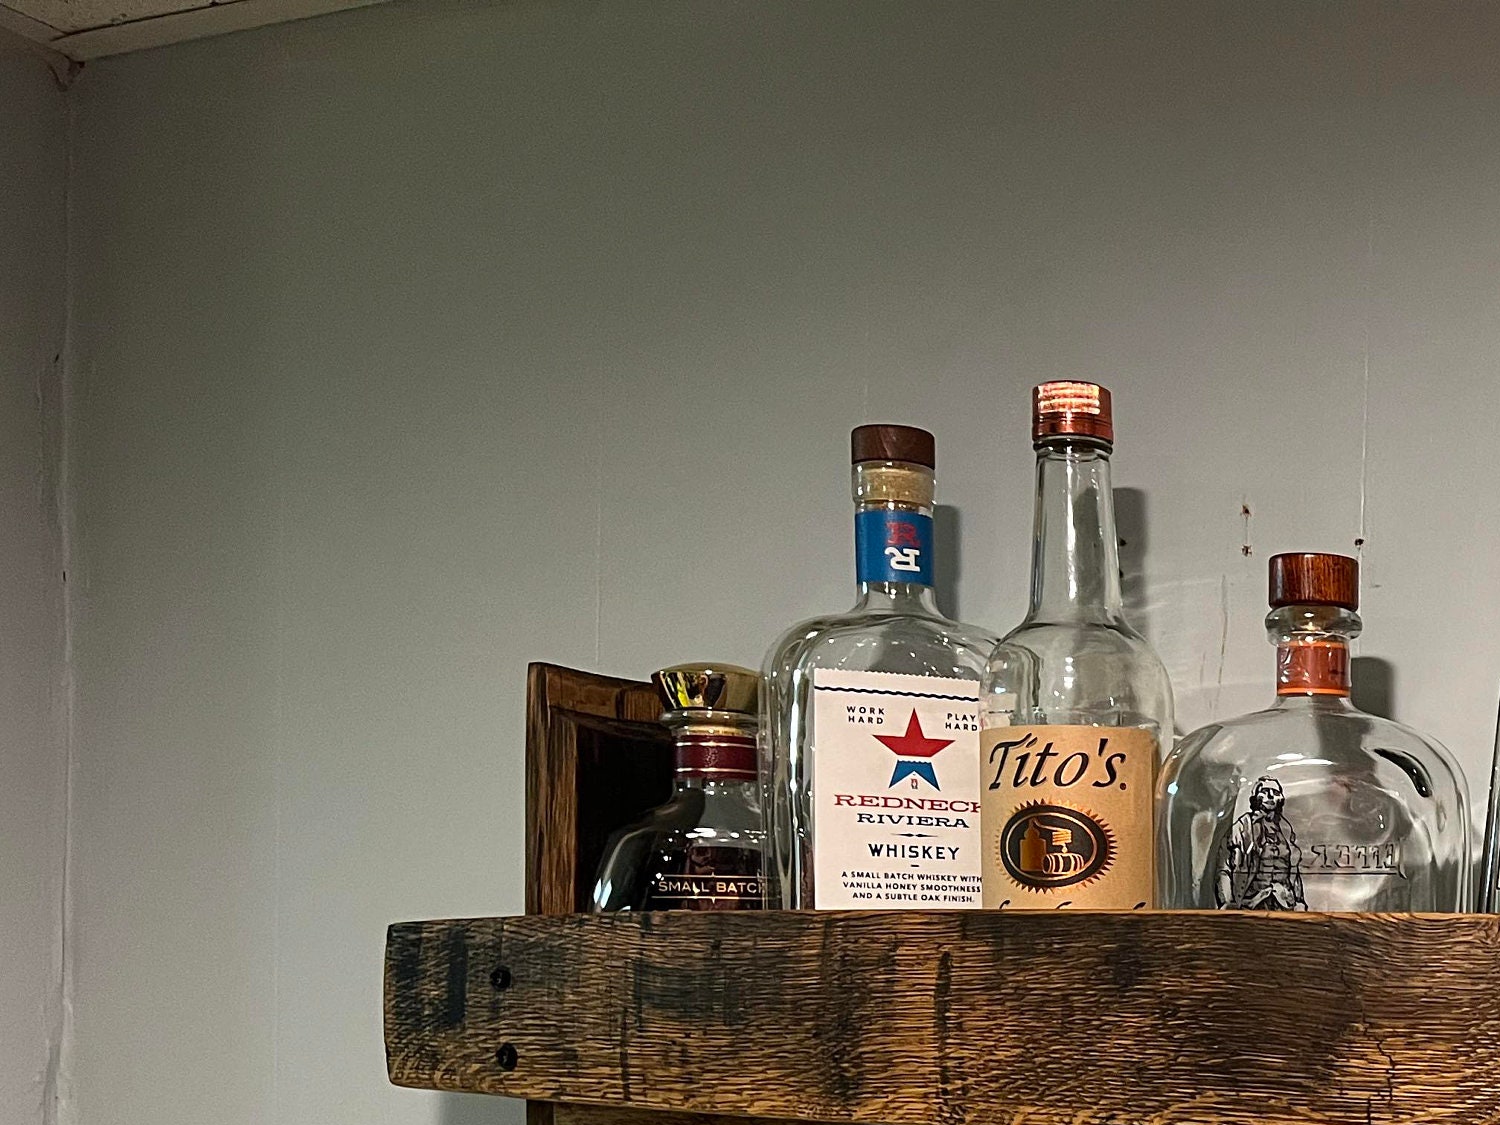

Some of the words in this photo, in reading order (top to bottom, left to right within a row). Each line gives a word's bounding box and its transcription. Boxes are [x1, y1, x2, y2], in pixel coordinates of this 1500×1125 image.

[846, 705, 885, 715] WORK
[848, 715, 884, 725] HARD
[947, 712, 977, 722] PLAY
[945, 722, 978, 732] HARD
[857, 813, 970, 828] RIVIERA
[868, 843, 960, 861] WHISKEY
[851, 871, 881, 879] SMALL
[884, 872, 914, 880] BATCH
[917, 874, 957, 882] WHISKEY
[960, 875, 982, 883] WITH
[658, 881, 710, 893] SMALL
[842, 881, 882, 889] VANILLA
[885, 882, 917, 891] HONEY
[920, 884, 981, 893] SMOOTHNESS
[885, 892, 918, 901] SUBTLE
[920, 894, 940, 902] OAK
